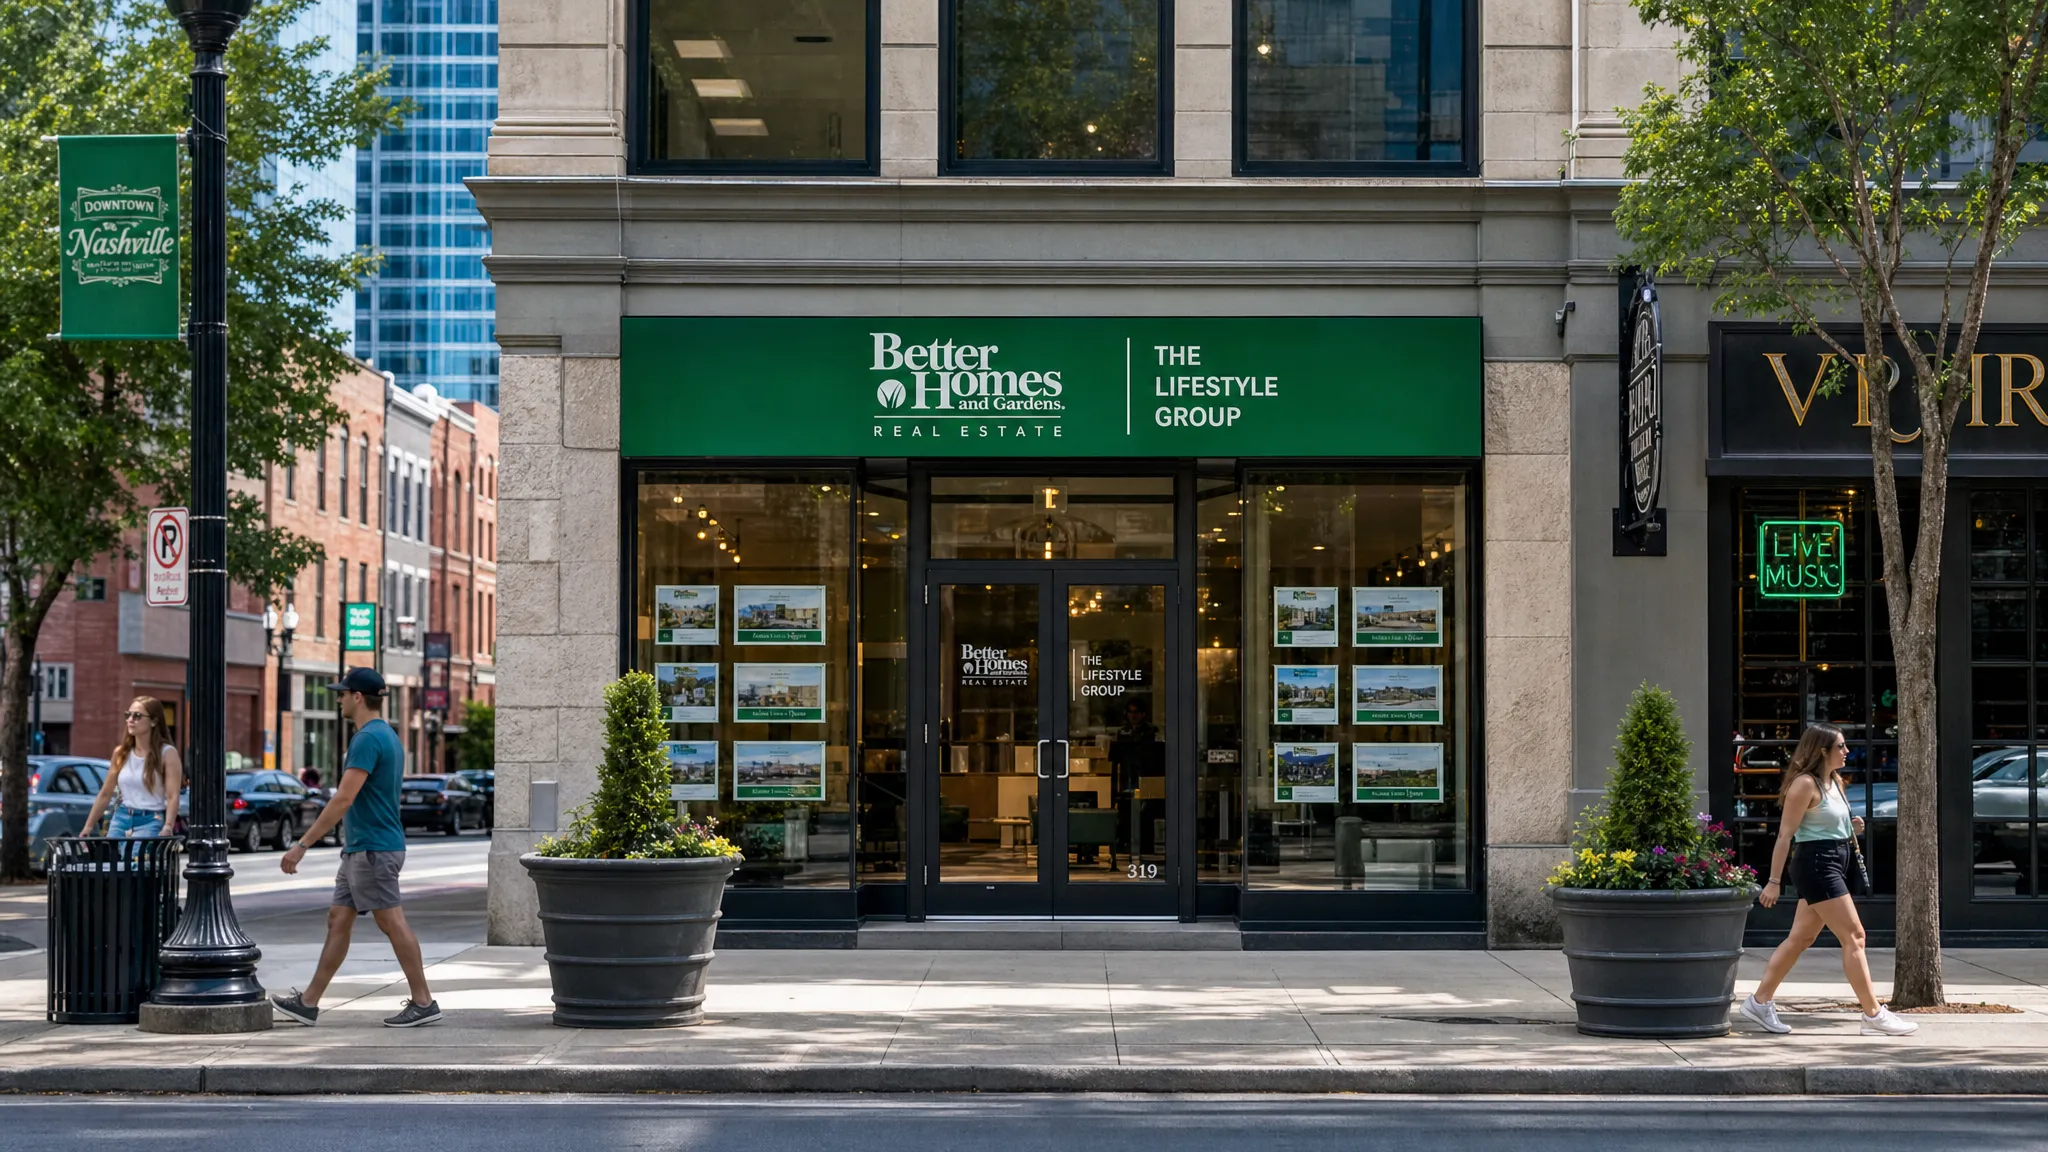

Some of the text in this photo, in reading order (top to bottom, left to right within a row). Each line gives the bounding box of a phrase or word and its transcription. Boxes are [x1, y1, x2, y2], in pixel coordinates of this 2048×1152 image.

[84, 200, 154, 213] DOWNTOWN
[66, 226, 175, 259] Nashville
[869, 332, 999, 371] Better
[1155, 346, 1201, 365] THE
[911, 371, 1063, 410] Homes
[1155, 377, 1279, 396] LIFESTYLE
[959, 397, 989, 410] and
[1155, 407, 1241, 427] GROUP
[873, 426, 1062, 437] REAL ESTATE
[1774, 532, 1832, 557] LIVE
[1766, 564, 1840, 588] MUSIC
[961, 644, 1007, 660] Better
[975, 659, 1028, 675] Homes
[1081, 655, 1102, 666] THE
[1081, 669, 1142, 681] LIFESTYLE
[1081, 685, 1125, 697] GROUP
[1127, 863, 1158, 879] 319
